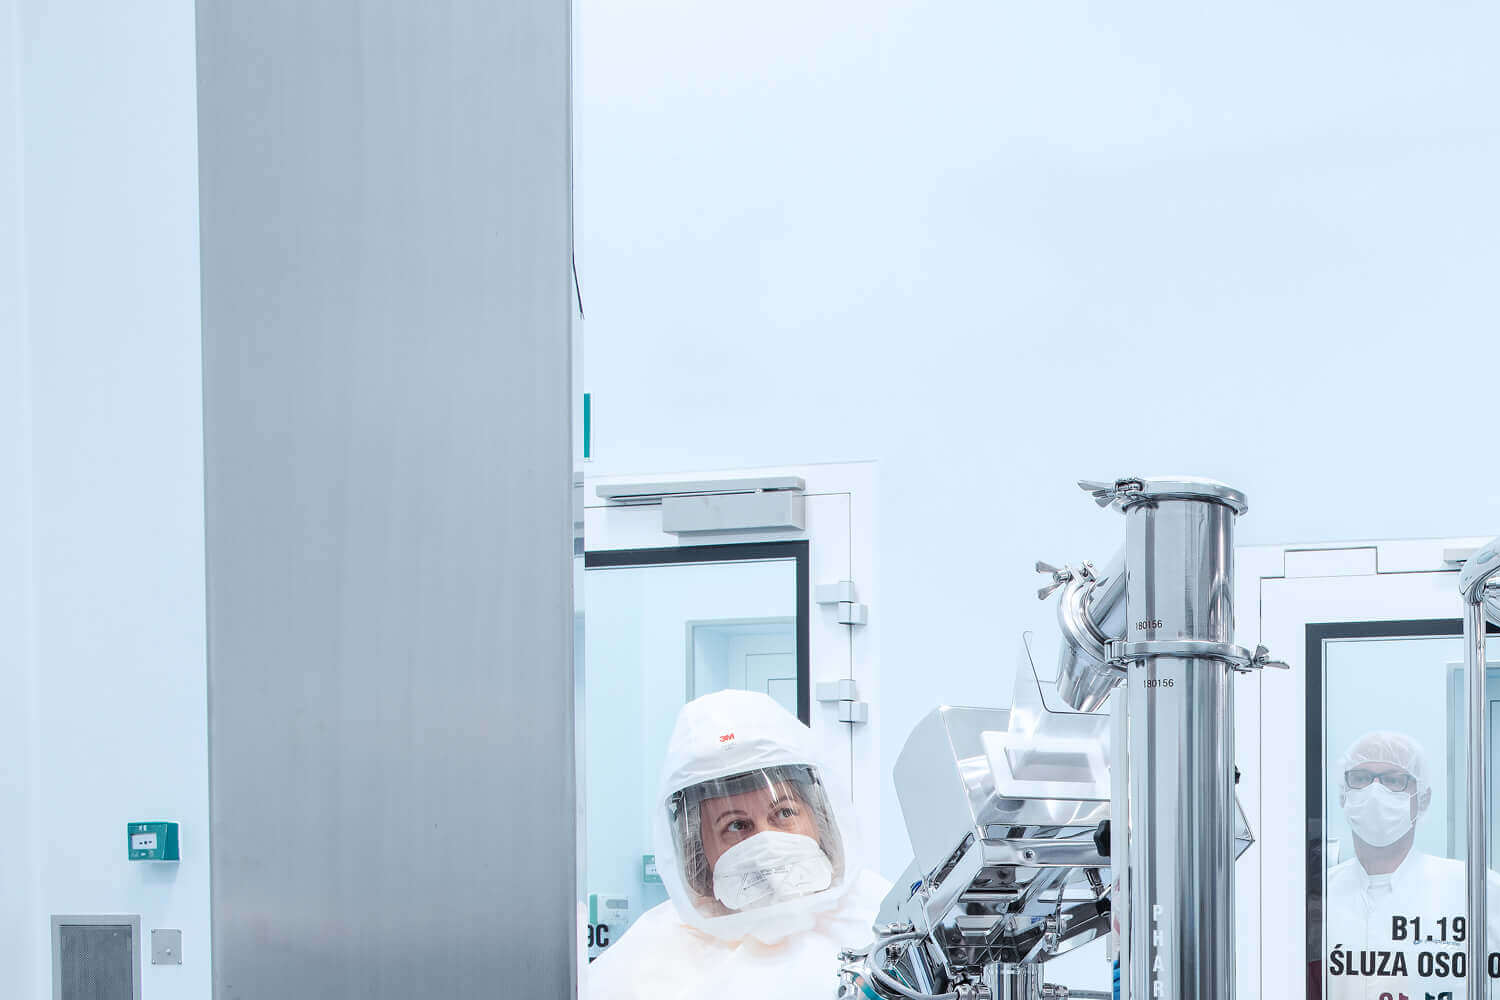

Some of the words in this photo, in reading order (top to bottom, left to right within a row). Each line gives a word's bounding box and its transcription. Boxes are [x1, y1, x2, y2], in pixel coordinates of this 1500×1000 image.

[720, 732, 735, 742] 3M
[1391, 915, 1466, 942] B1.19
[1329, 945, 1408, 977] ŚLUZA
